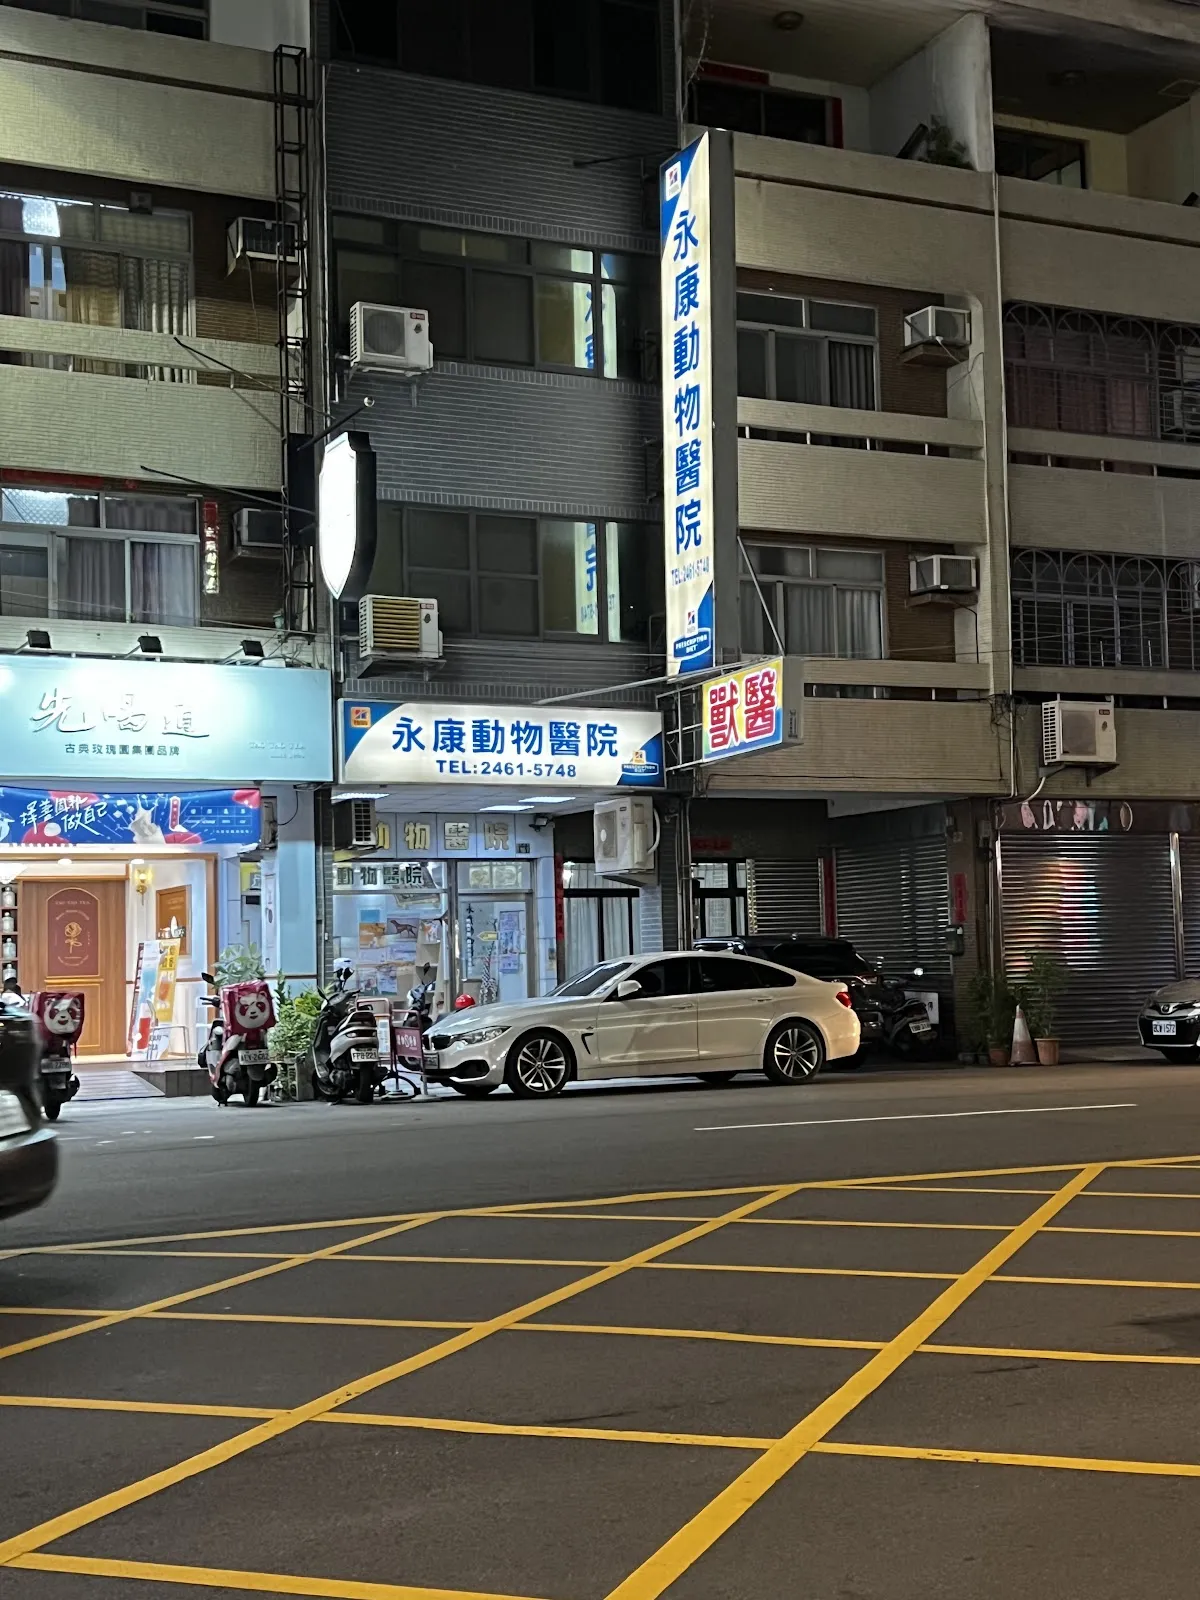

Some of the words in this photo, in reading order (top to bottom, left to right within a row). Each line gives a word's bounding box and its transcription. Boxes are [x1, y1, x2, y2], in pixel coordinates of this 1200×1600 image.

[673, 209, 702, 554] 永康動物醫院
[709, 670, 775, 748] 獸醫
[392, 716, 618, 757] 永康動物醫院
[436, 760, 577, 777] TEL:2461-5748
[61, 801, 108, 836] 做自己
